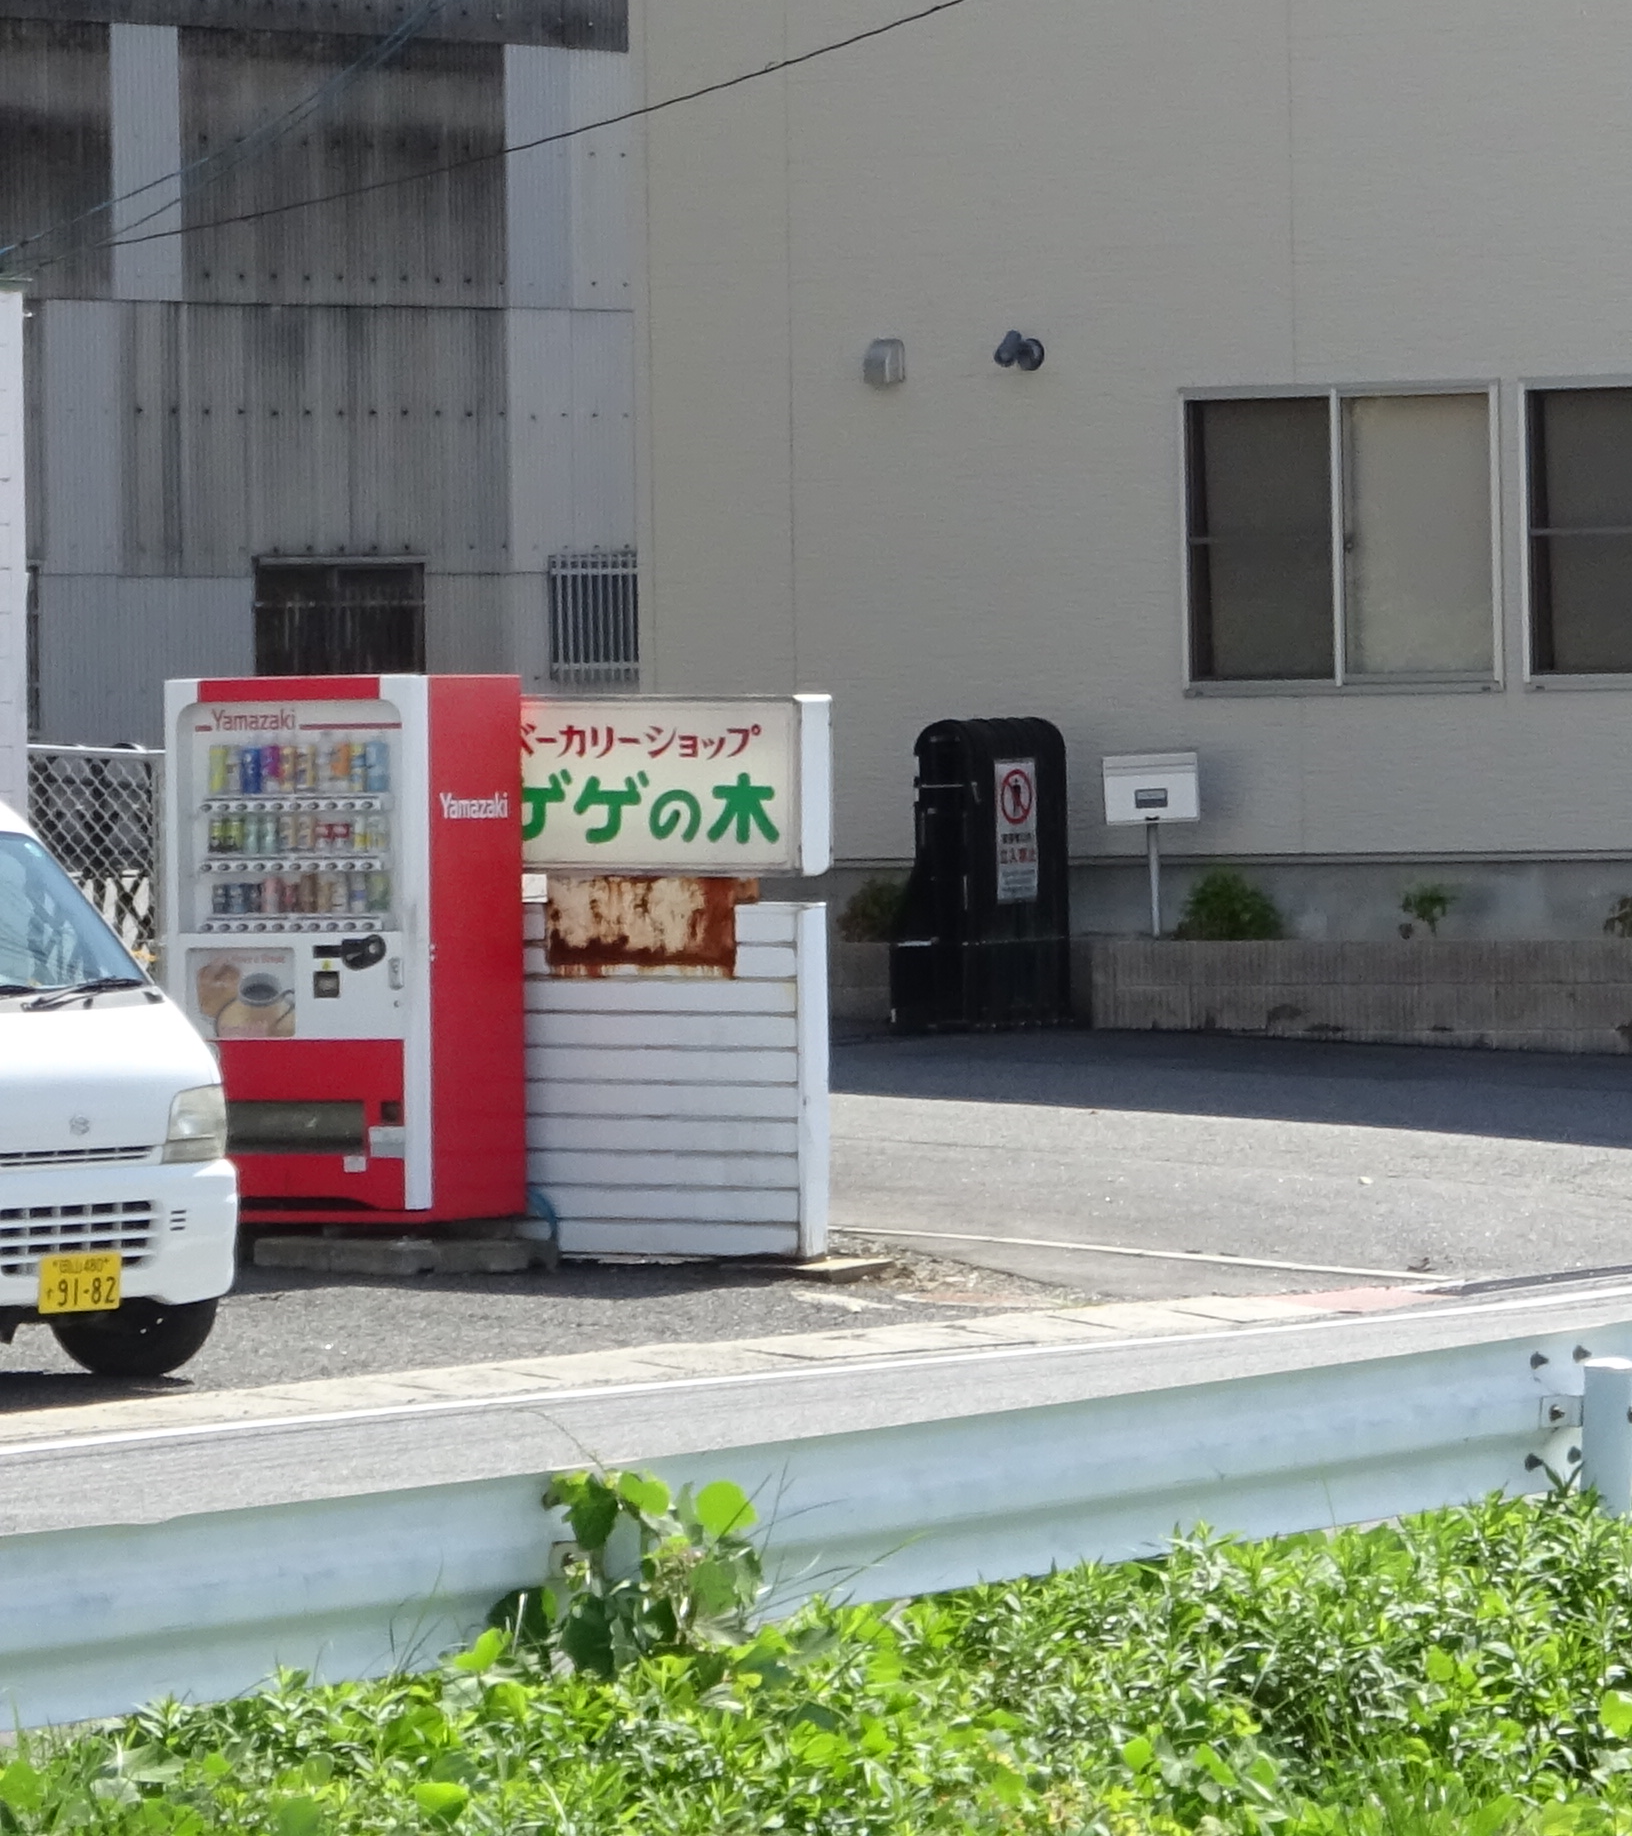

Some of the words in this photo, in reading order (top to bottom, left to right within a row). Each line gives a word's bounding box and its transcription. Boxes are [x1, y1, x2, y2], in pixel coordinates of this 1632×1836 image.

[212, 708, 296, 731] Yamazaki
[439, 791, 510, 820] Yamazaki
[58, 1276, 116, 1307] 91-82
